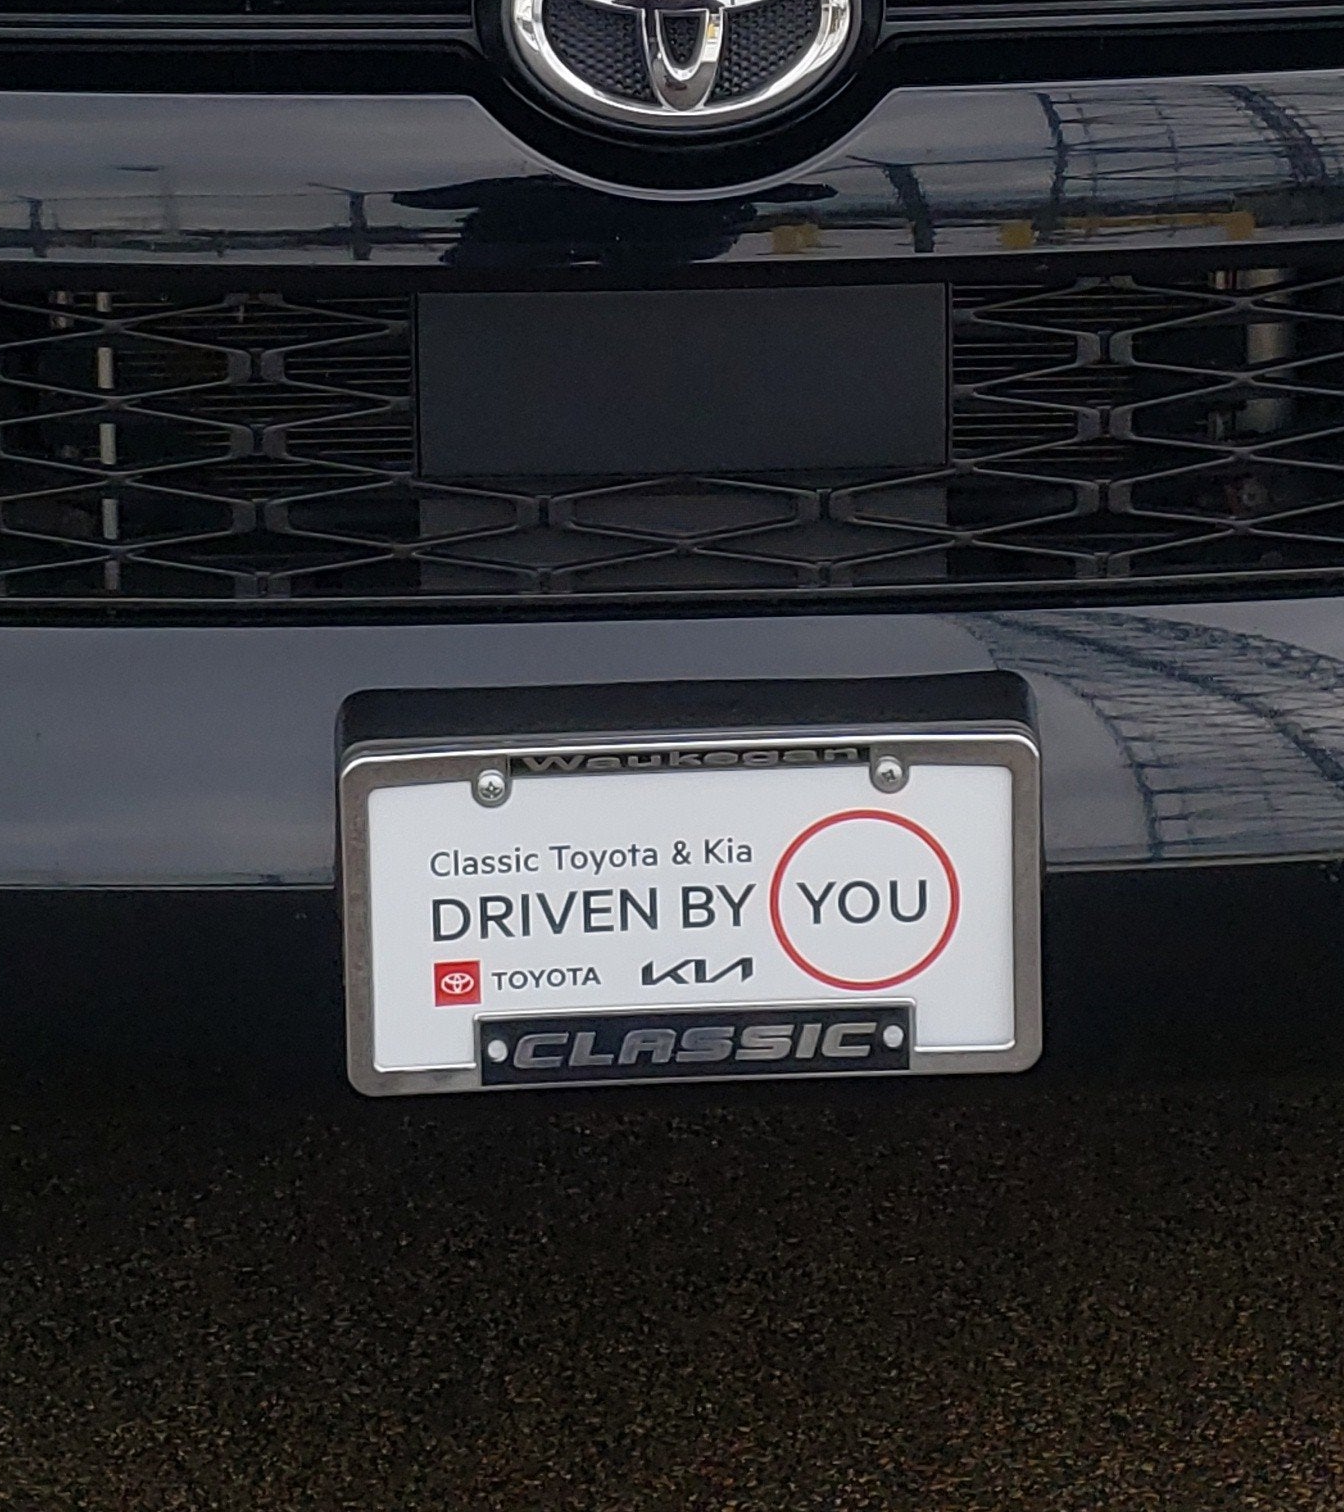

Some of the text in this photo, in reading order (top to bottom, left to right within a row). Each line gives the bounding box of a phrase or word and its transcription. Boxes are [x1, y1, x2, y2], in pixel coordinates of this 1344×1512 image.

[430, 838, 753, 877] Classic Toyota & Kia
[431, 879, 928, 942] DRIVEN BY YOU
[491, 966, 601, 990] TOYOTA
[512, 1021, 877, 1068] CLASSIC
